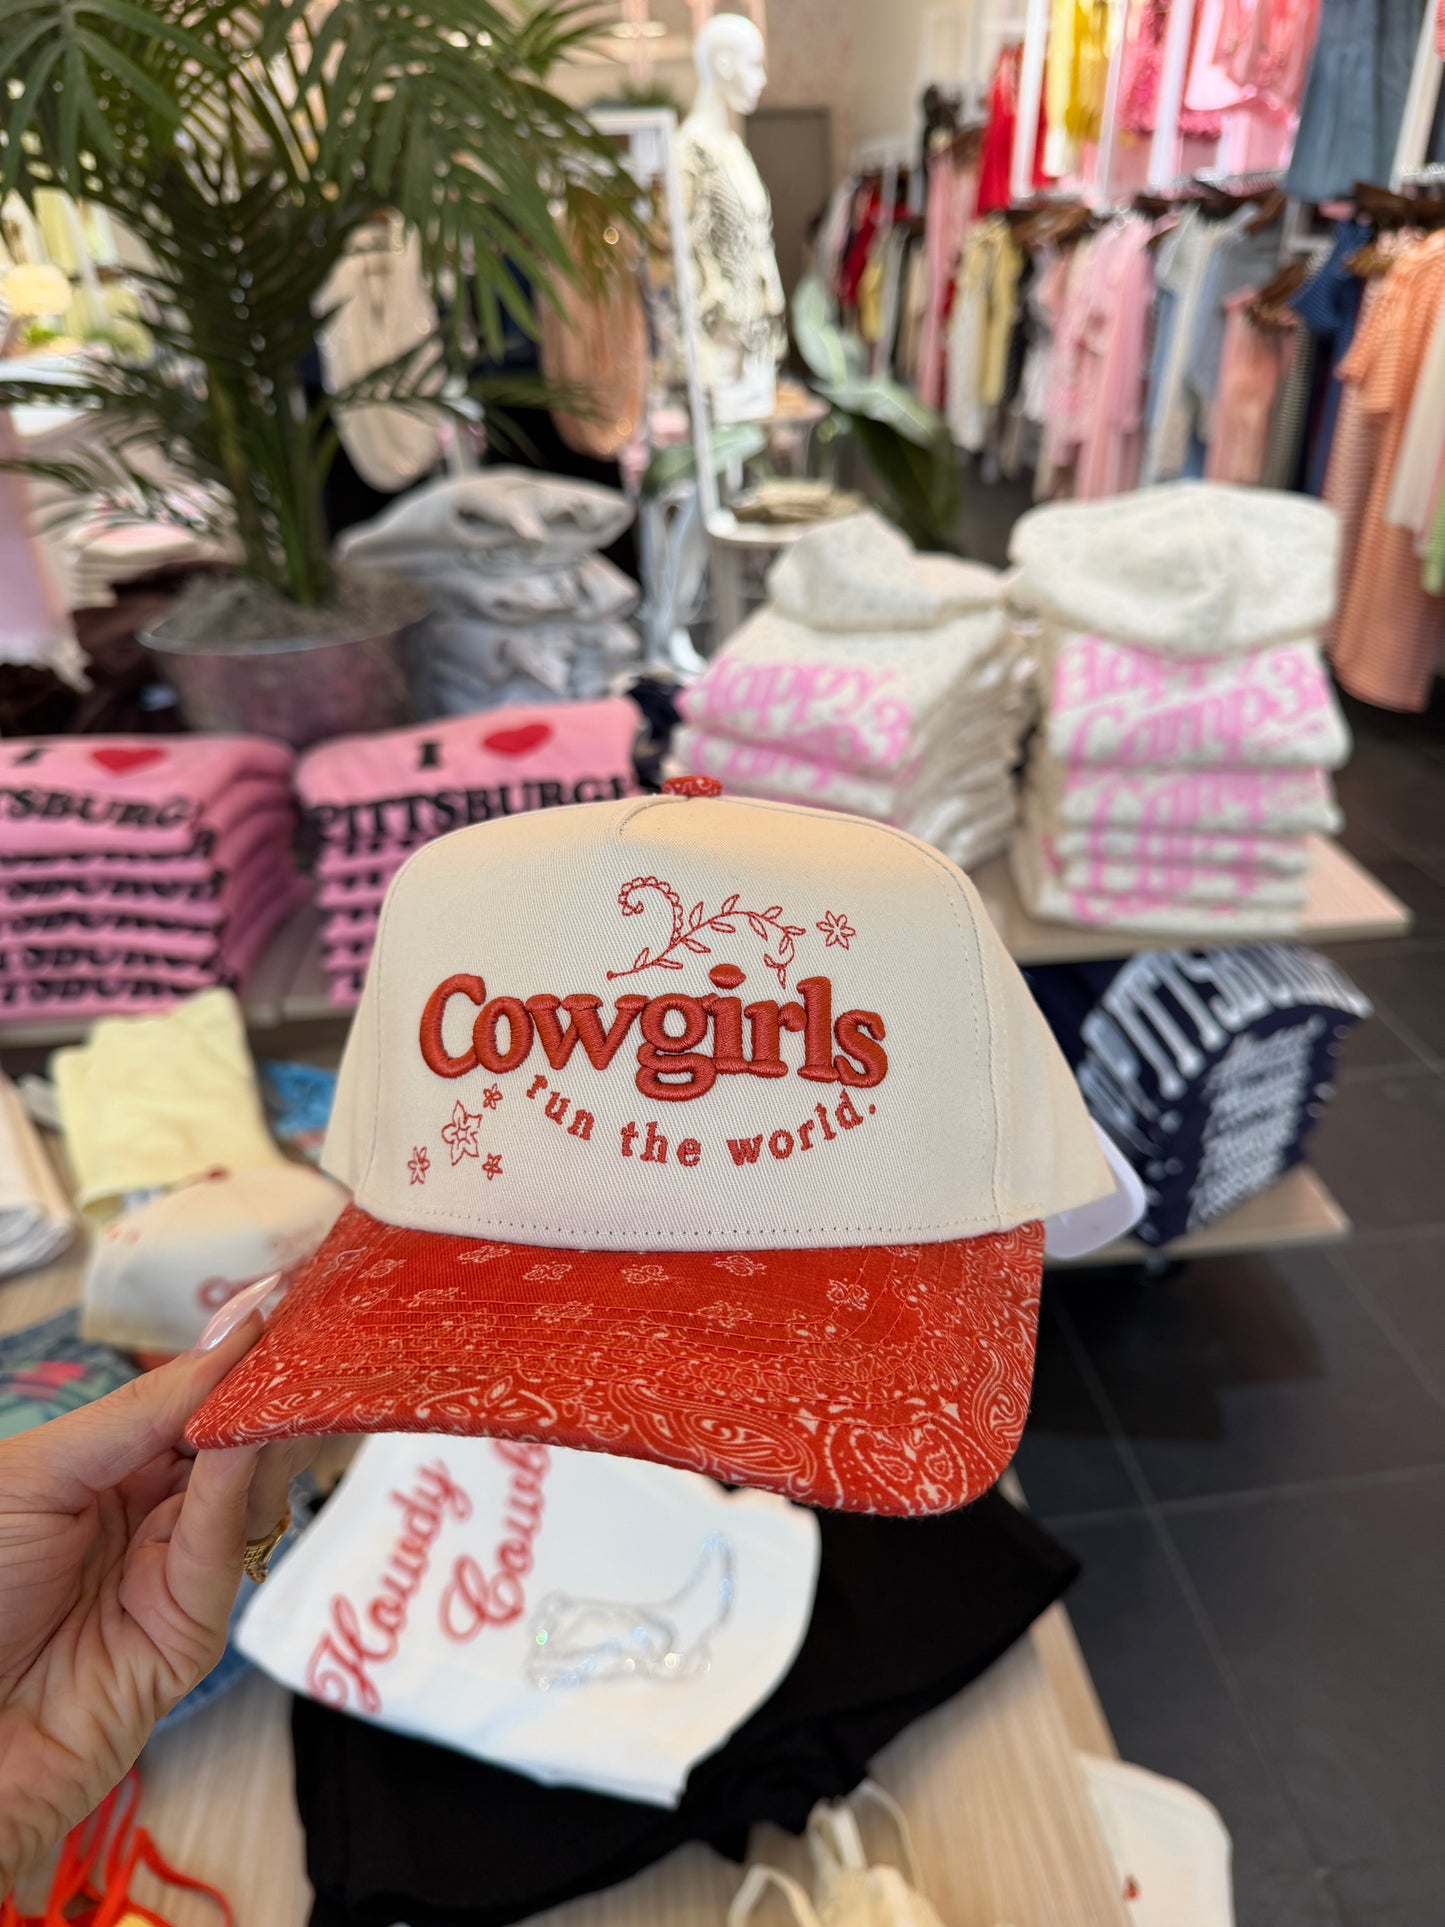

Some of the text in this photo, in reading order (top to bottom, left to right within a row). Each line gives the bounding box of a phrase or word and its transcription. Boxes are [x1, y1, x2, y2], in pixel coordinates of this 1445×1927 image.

[417, 740, 441, 769] I
[420, 964, 888, 1102] Cowgirls
[526, 1075, 877, 1167] run the world.
[304, 1457, 474, 1715] Howdy
[437, 1438, 552, 1644] Cowb
